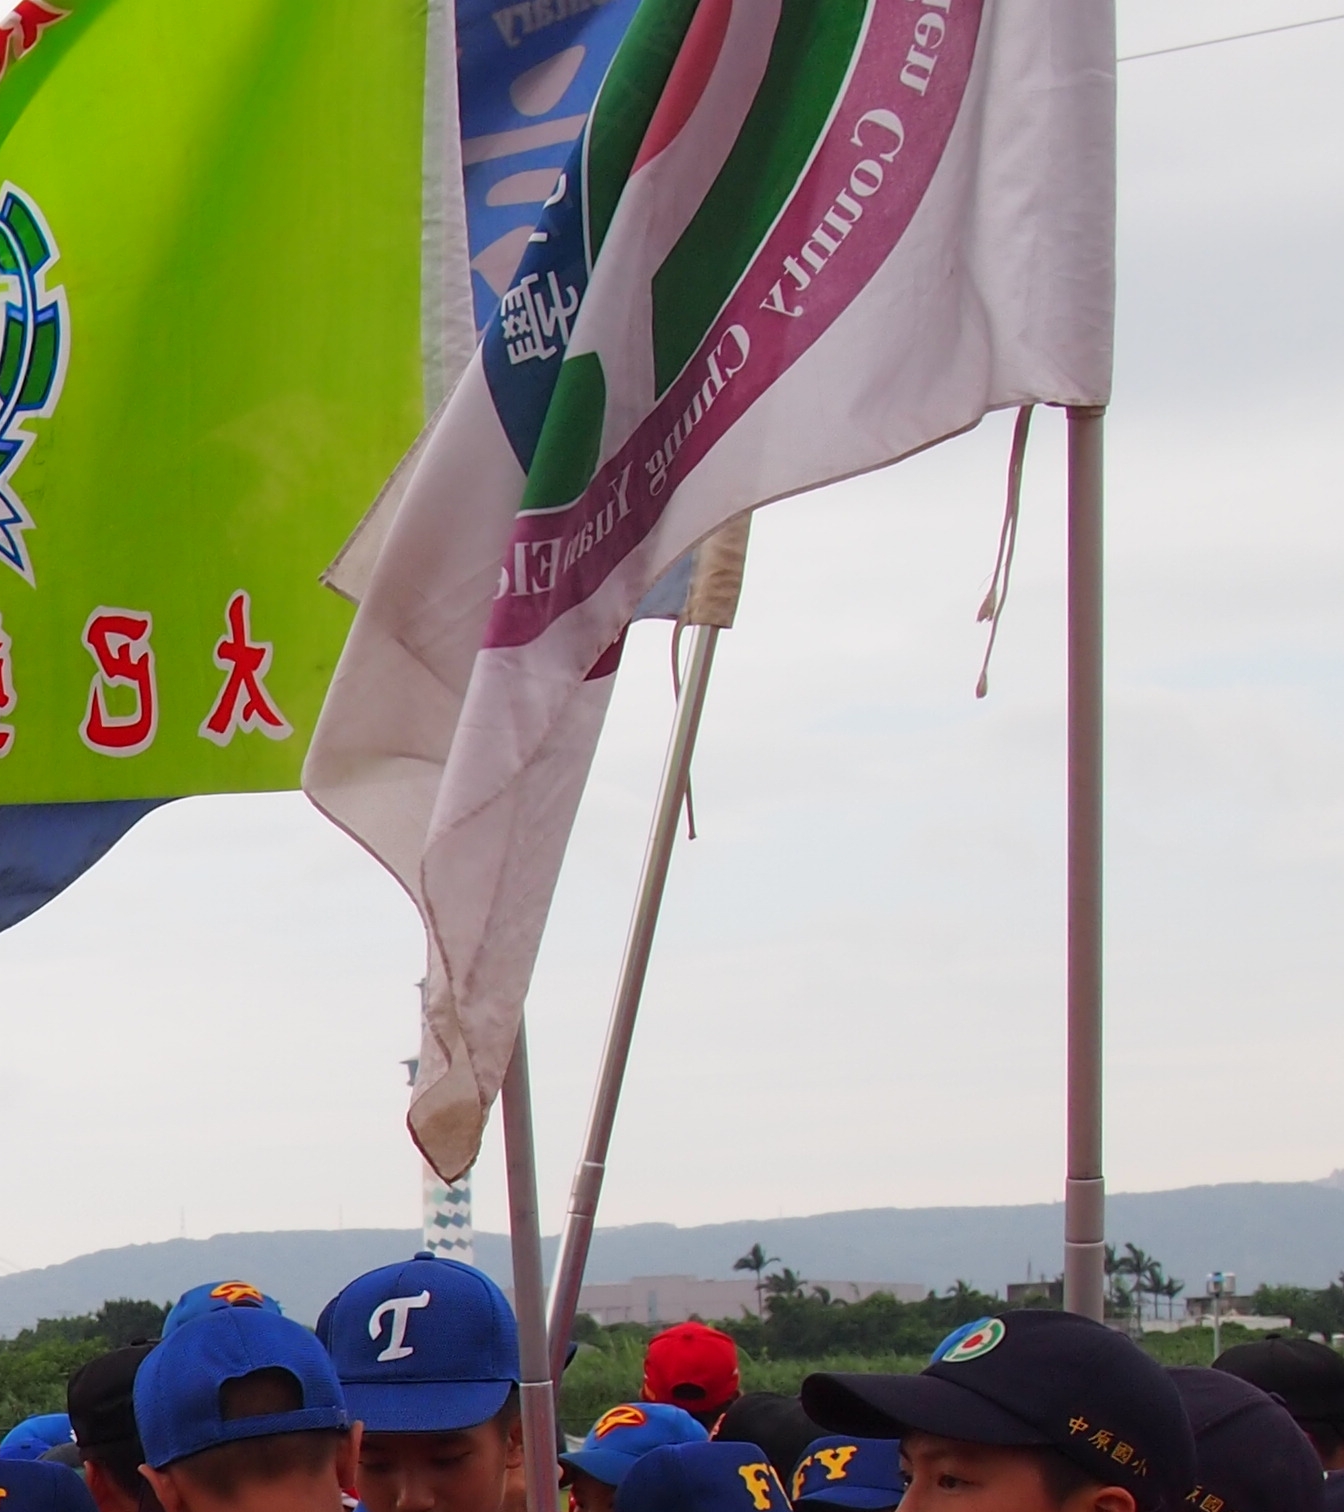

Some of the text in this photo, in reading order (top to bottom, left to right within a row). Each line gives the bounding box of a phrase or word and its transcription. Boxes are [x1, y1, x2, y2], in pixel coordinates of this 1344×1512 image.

[367, 1289, 431, 1363] T
[1067, 1415, 1149, 1477] 中原國小
